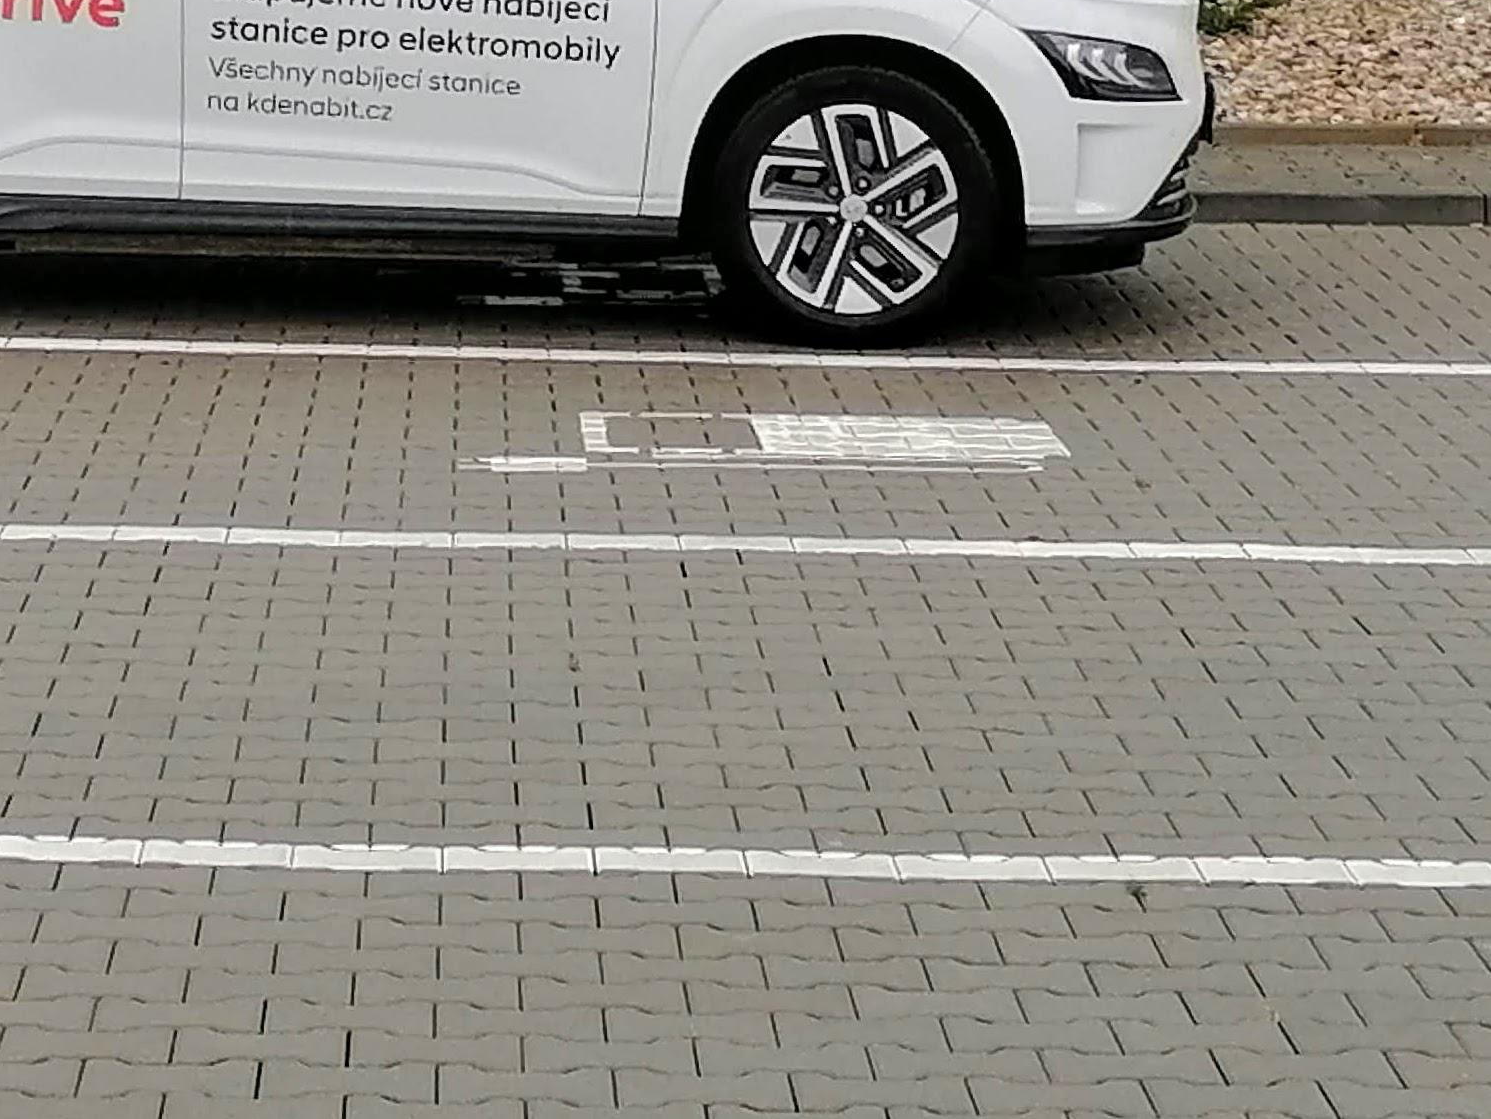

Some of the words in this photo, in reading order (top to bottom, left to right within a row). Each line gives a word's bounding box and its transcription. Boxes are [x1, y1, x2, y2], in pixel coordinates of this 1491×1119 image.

[211, 17, 328, 45] stanice
[337, 28, 390, 52] pro
[399, 26, 620, 69] elektromobily
[209, 57, 317, 87] Všechny
[322, 64, 423, 92] nabíjecí
[428, 71, 521, 95] stanice
[208, 93, 239, 112] na
[247, 91, 393, 121] kdenabit.cz
